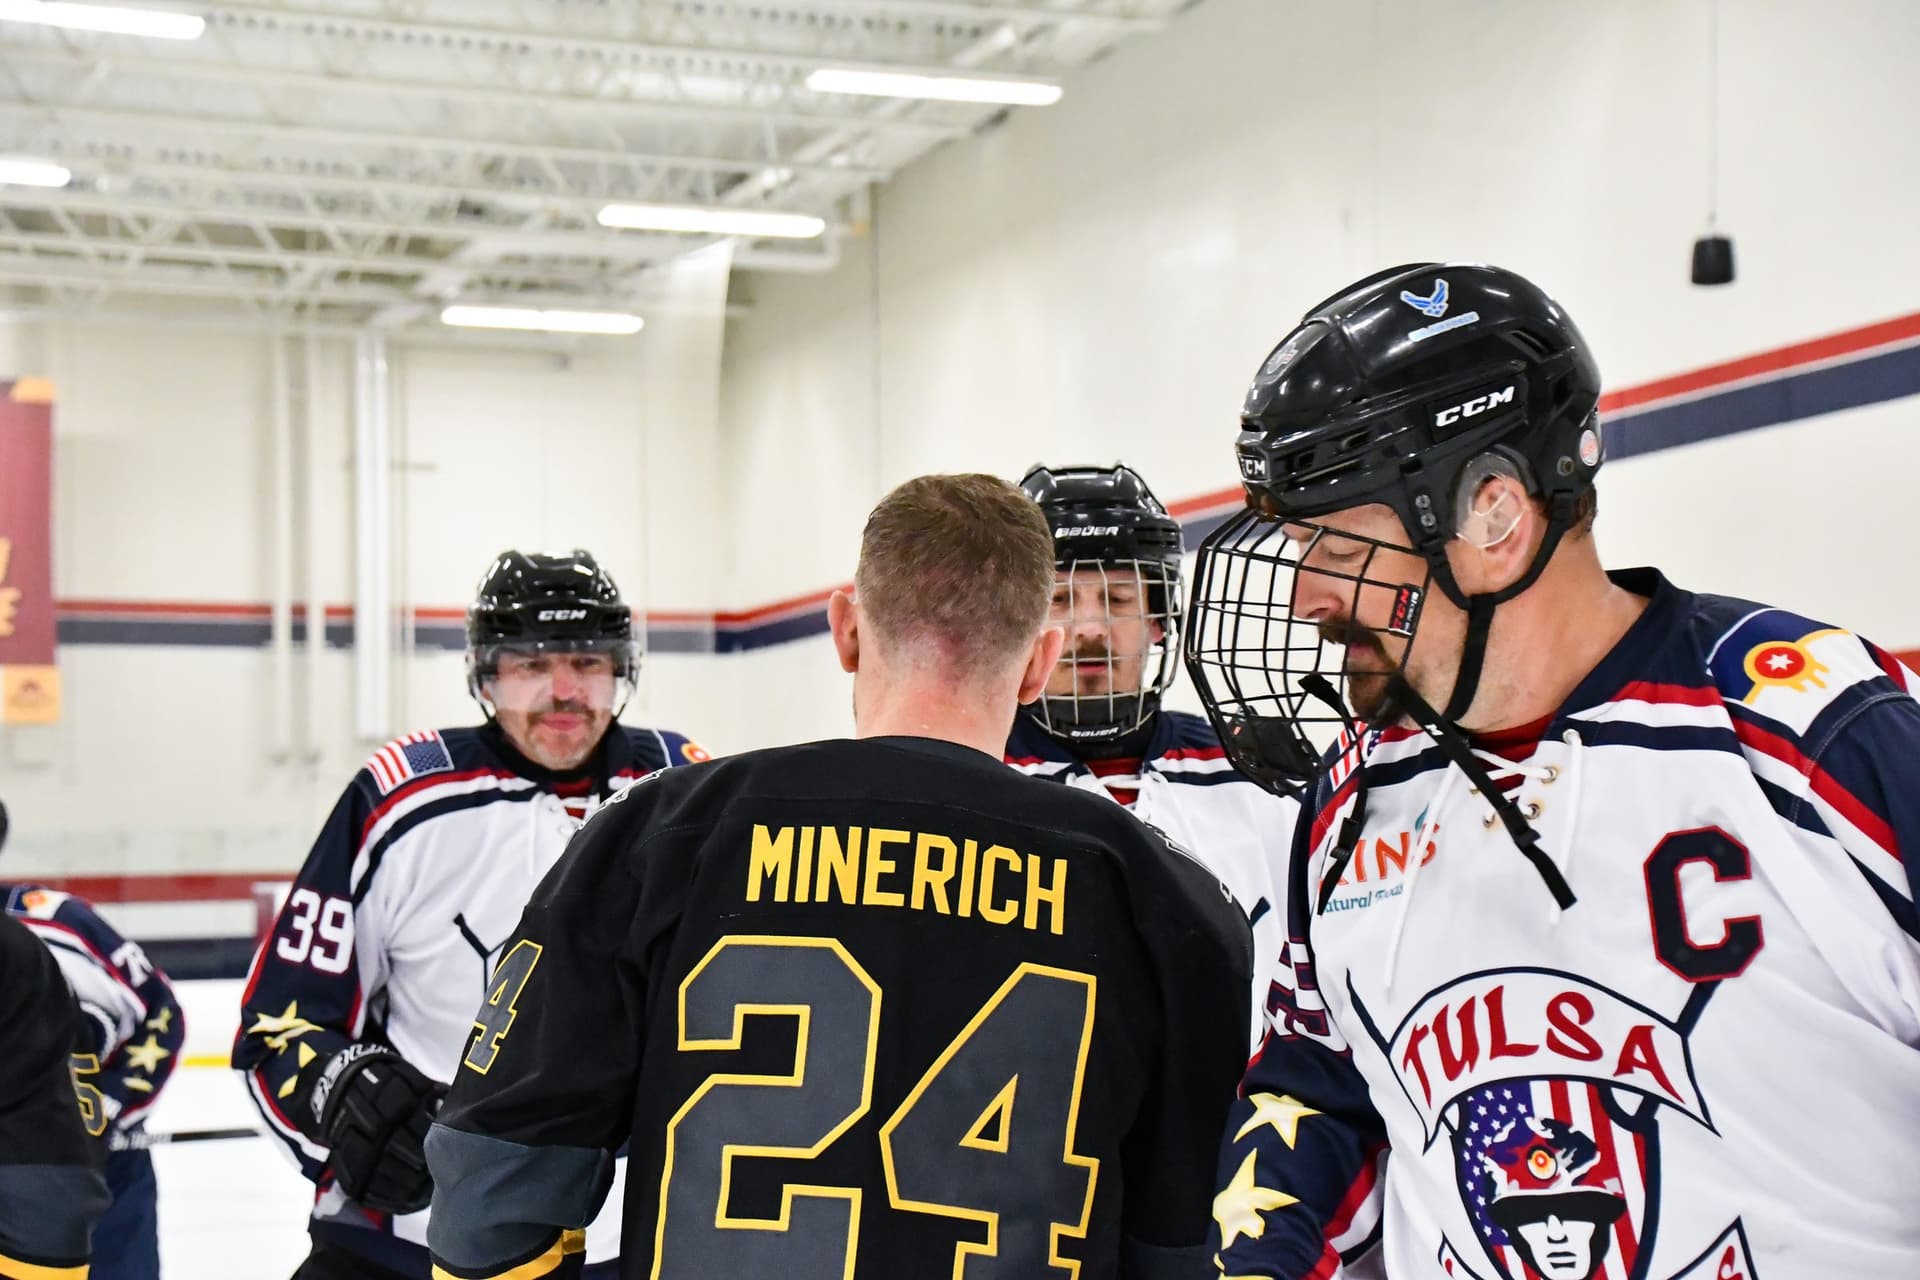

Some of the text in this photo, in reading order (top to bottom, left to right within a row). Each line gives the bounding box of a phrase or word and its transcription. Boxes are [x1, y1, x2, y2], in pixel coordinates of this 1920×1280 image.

[1435, 385, 1515, 427] CCM
[1055, 525, 1119, 538] BAUER
[538, 610, 587, 621] CCM
[1070, 726, 1119, 738] BAUER
[746, 824, 1067, 935] MINERICH
[1643, 825, 1764, 982] C
[277, 888, 355, 974] 39
[1403, 985, 1684, 1110] TULSA
[650, 935, 1100, 1280] 24
